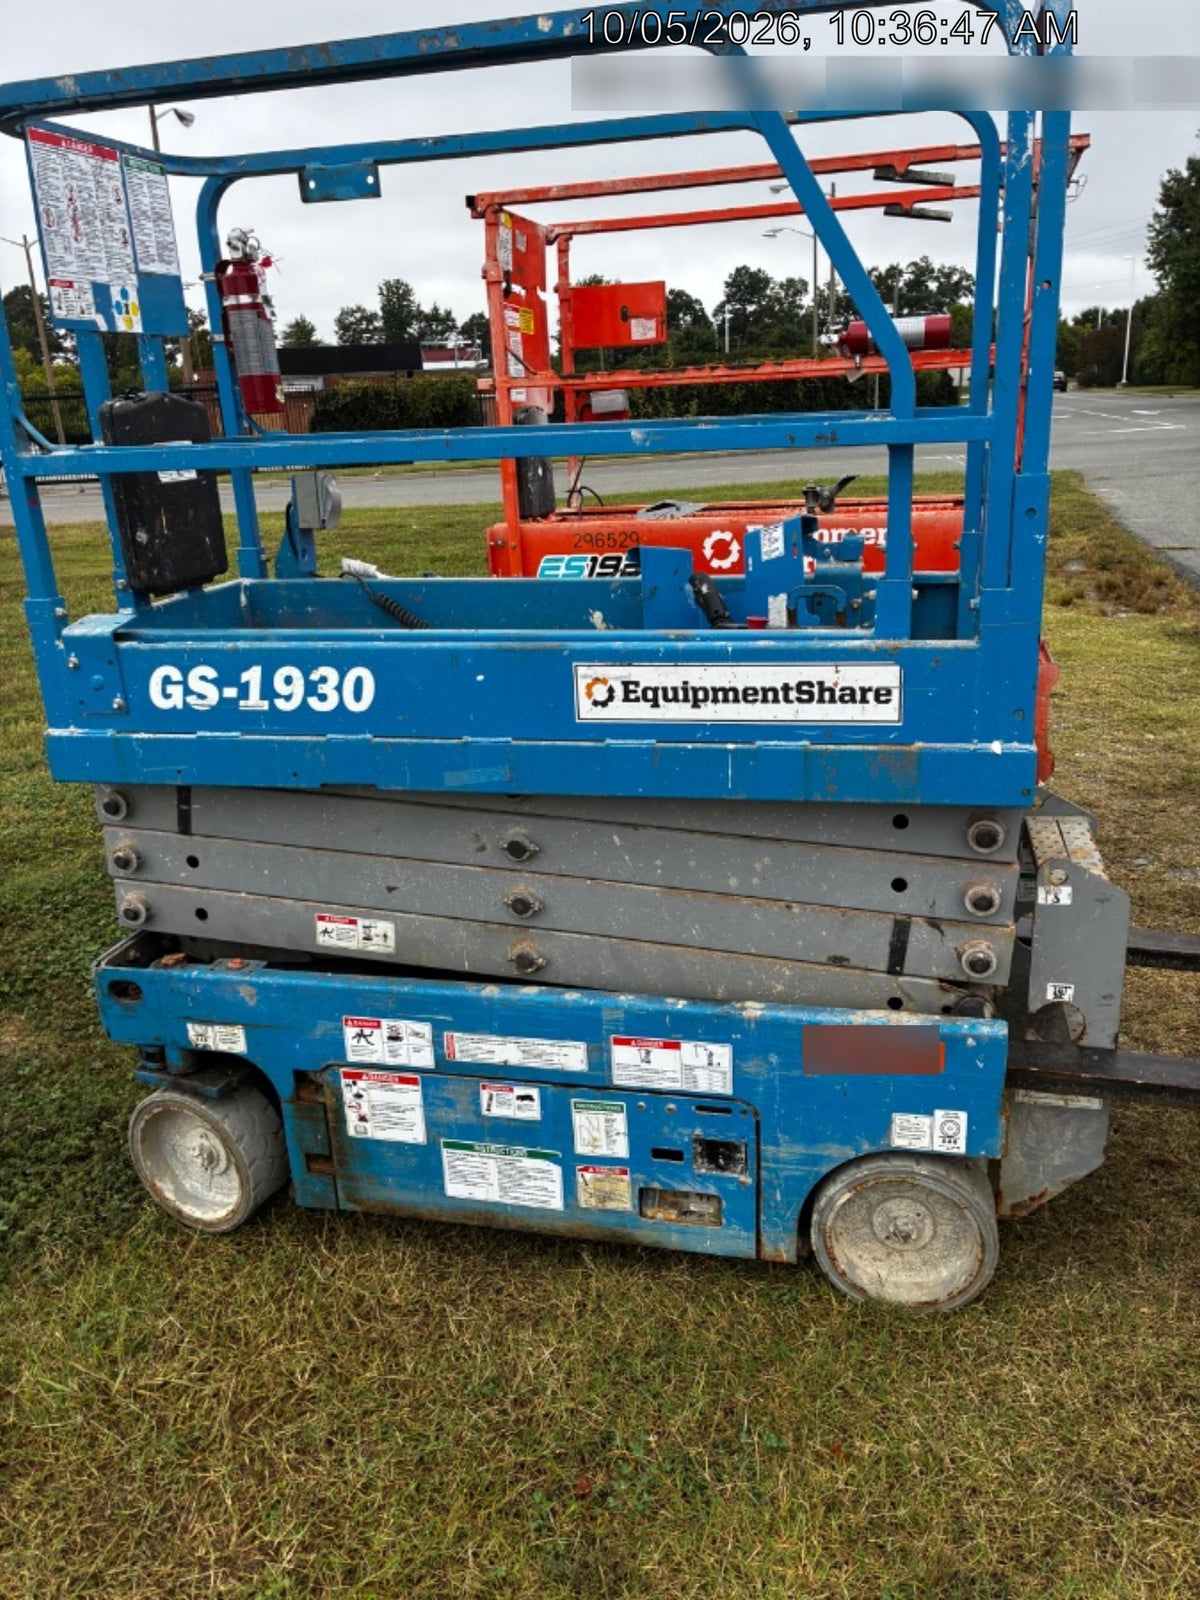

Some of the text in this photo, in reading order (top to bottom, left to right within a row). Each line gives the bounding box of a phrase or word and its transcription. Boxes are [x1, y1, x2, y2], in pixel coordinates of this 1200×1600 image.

[573, 530, 641, 549] 296529
[149, 664, 376, 713] GS-1930
[621, 680, 893, 709] EquipmentShare
